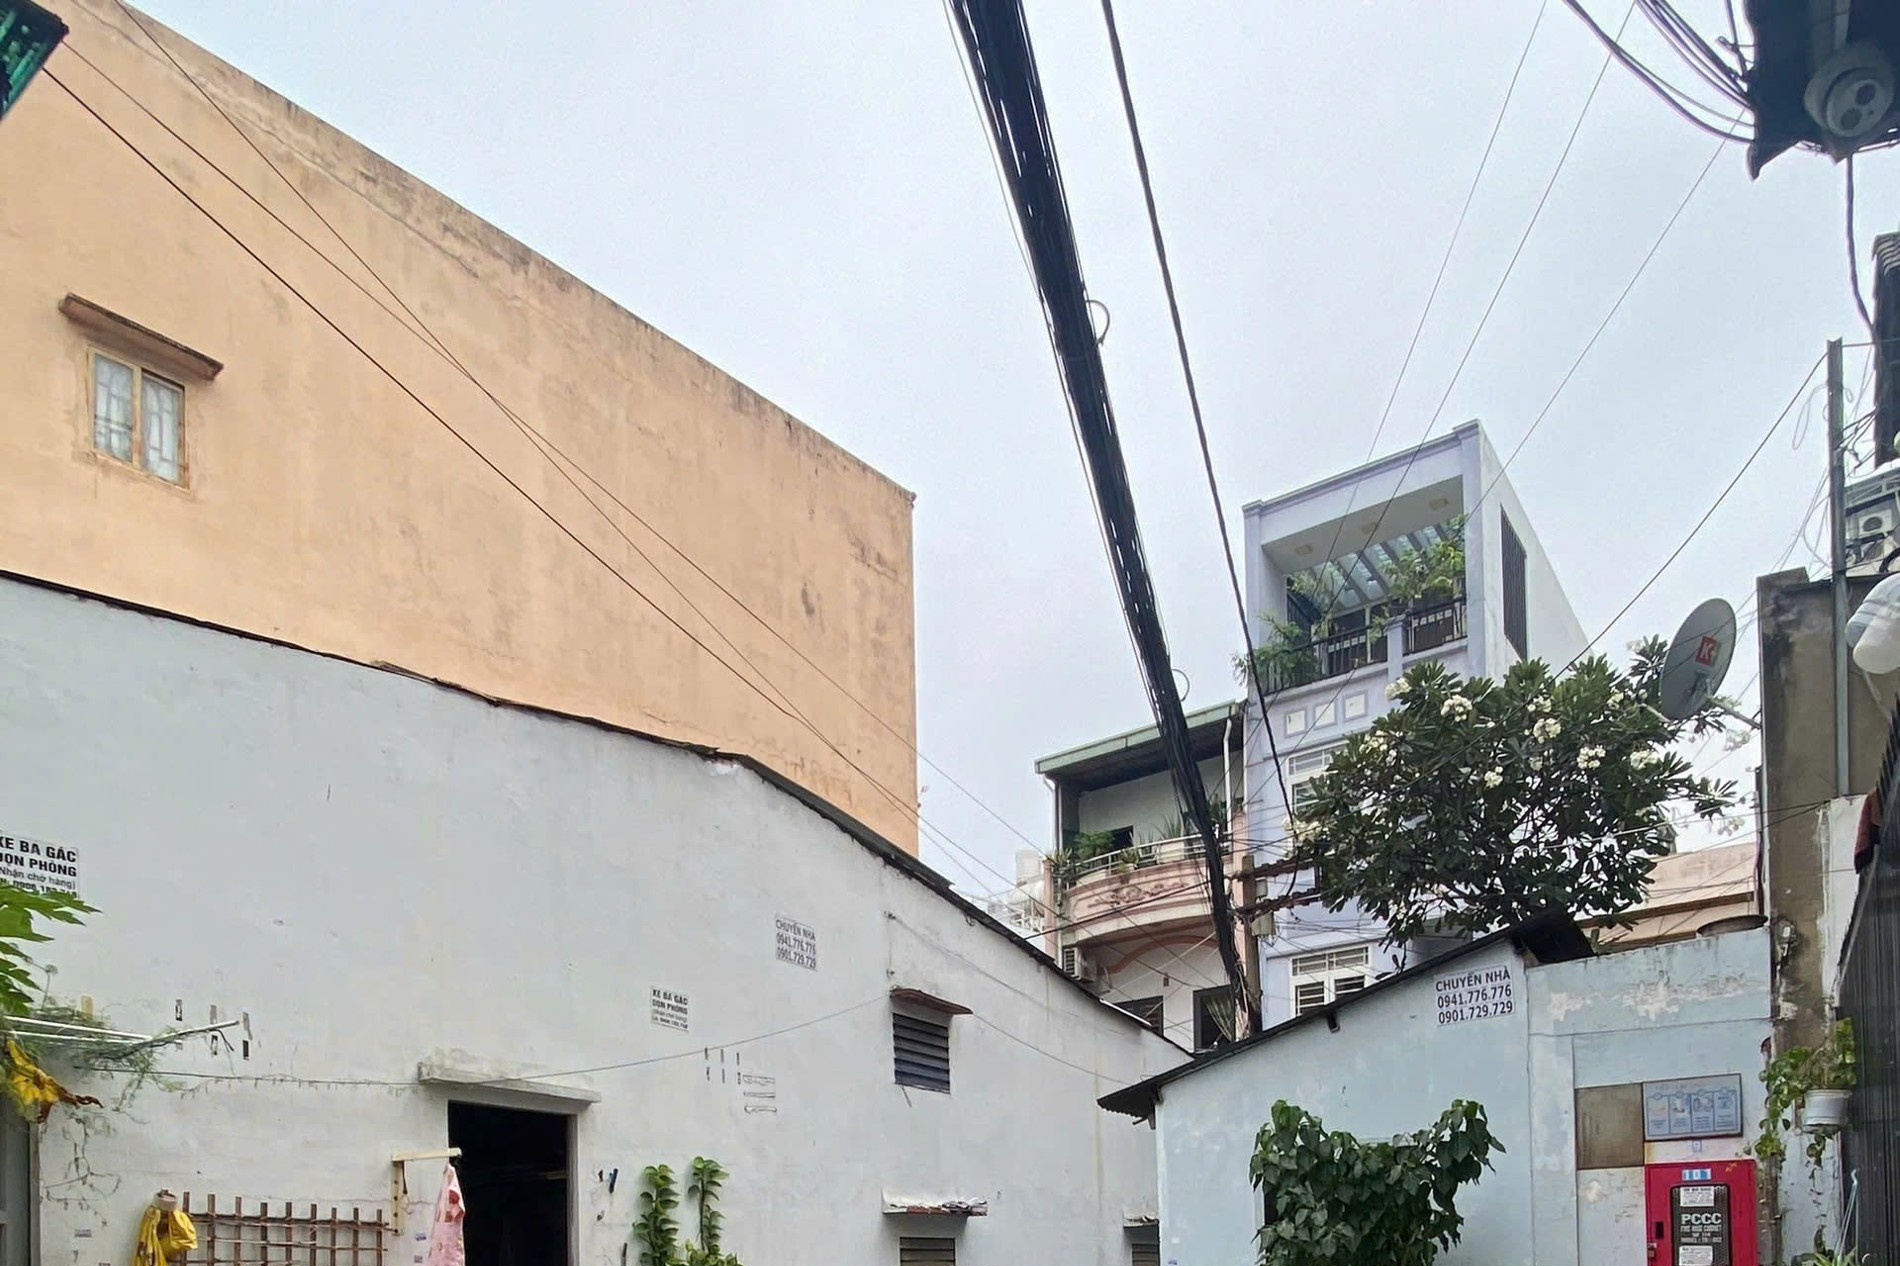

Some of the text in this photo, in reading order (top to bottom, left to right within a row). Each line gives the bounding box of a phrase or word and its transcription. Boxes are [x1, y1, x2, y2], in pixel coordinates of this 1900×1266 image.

[19, 840, 41, 856] BA
[46, 846, 76, 863] GÁC
[29, 858, 77, 877] PHÒNG
[1485, 966, 1511, 983] NHÀ
[1437, 984, 1512, 1009] 0941.776.776
[1438, 1000, 1513, 1024] 0901.729.729
[1681, 1213, 1722, 1225] PCCC
